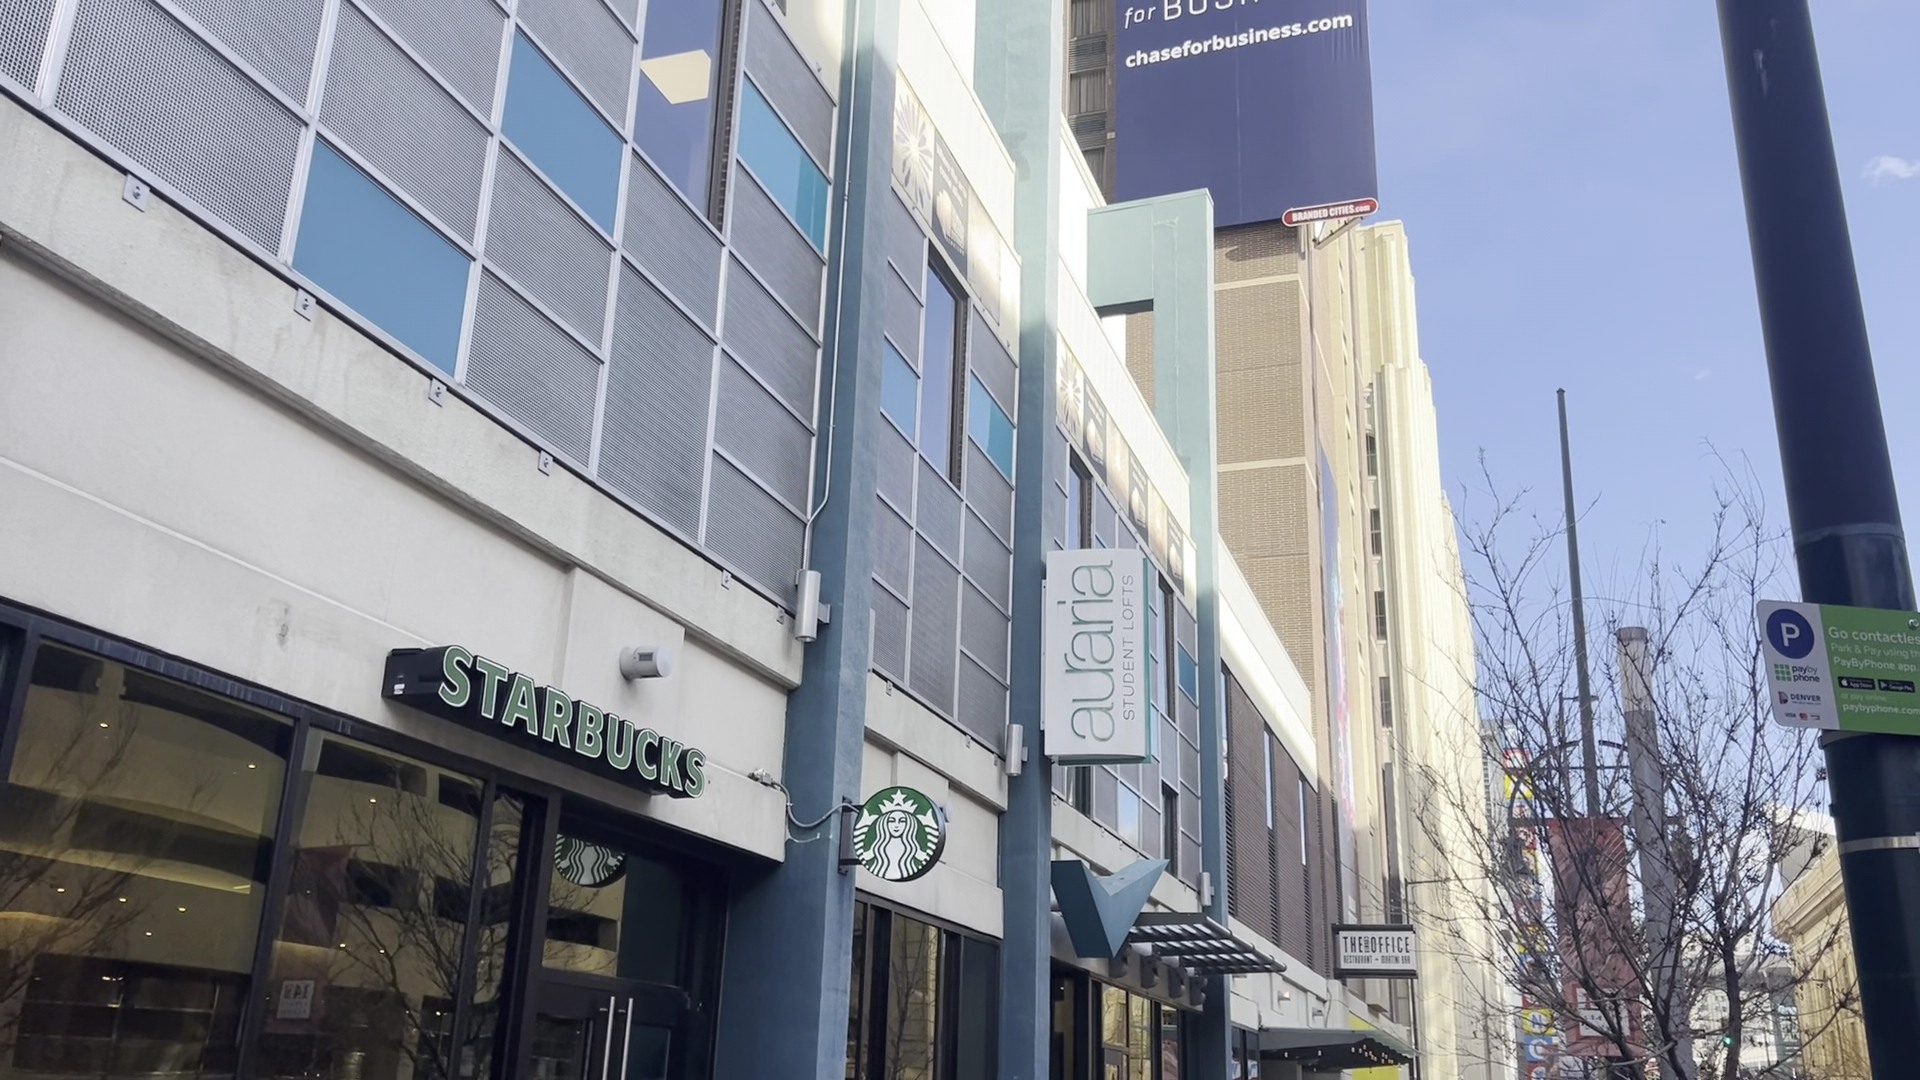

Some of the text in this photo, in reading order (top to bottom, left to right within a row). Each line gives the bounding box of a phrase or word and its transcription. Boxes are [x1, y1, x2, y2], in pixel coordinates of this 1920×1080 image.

[1124, 7, 1156, 29] for
[1125, 14, 1353, 68] chaseforbusiness.com
[1291, 208, 1328, 222] BRANDED
[1780, 622, 1800, 647] P
[1828, 626, 1848, 639] Go
[1057, 560, 1115, 742] auraria
[1121, 574, 1135, 721] STUDENT LOFTS
[1831, 642, 1852, 652] Park
[1854, 644, 1862, 653] &
[1863, 645, 1882, 657] Pay
[1883, 649, 1909, 660] using
[1833, 656, 1896, 670] PayByPhone
[1793, 674, 1820, 683] phone
[1790, 693, 1822, 702] DENVER
[438, 645, 707, 798] STARBUCKS
[1342, 936, 1363, 953] THE
[1370, 936, 1410, 953] OFFICE
